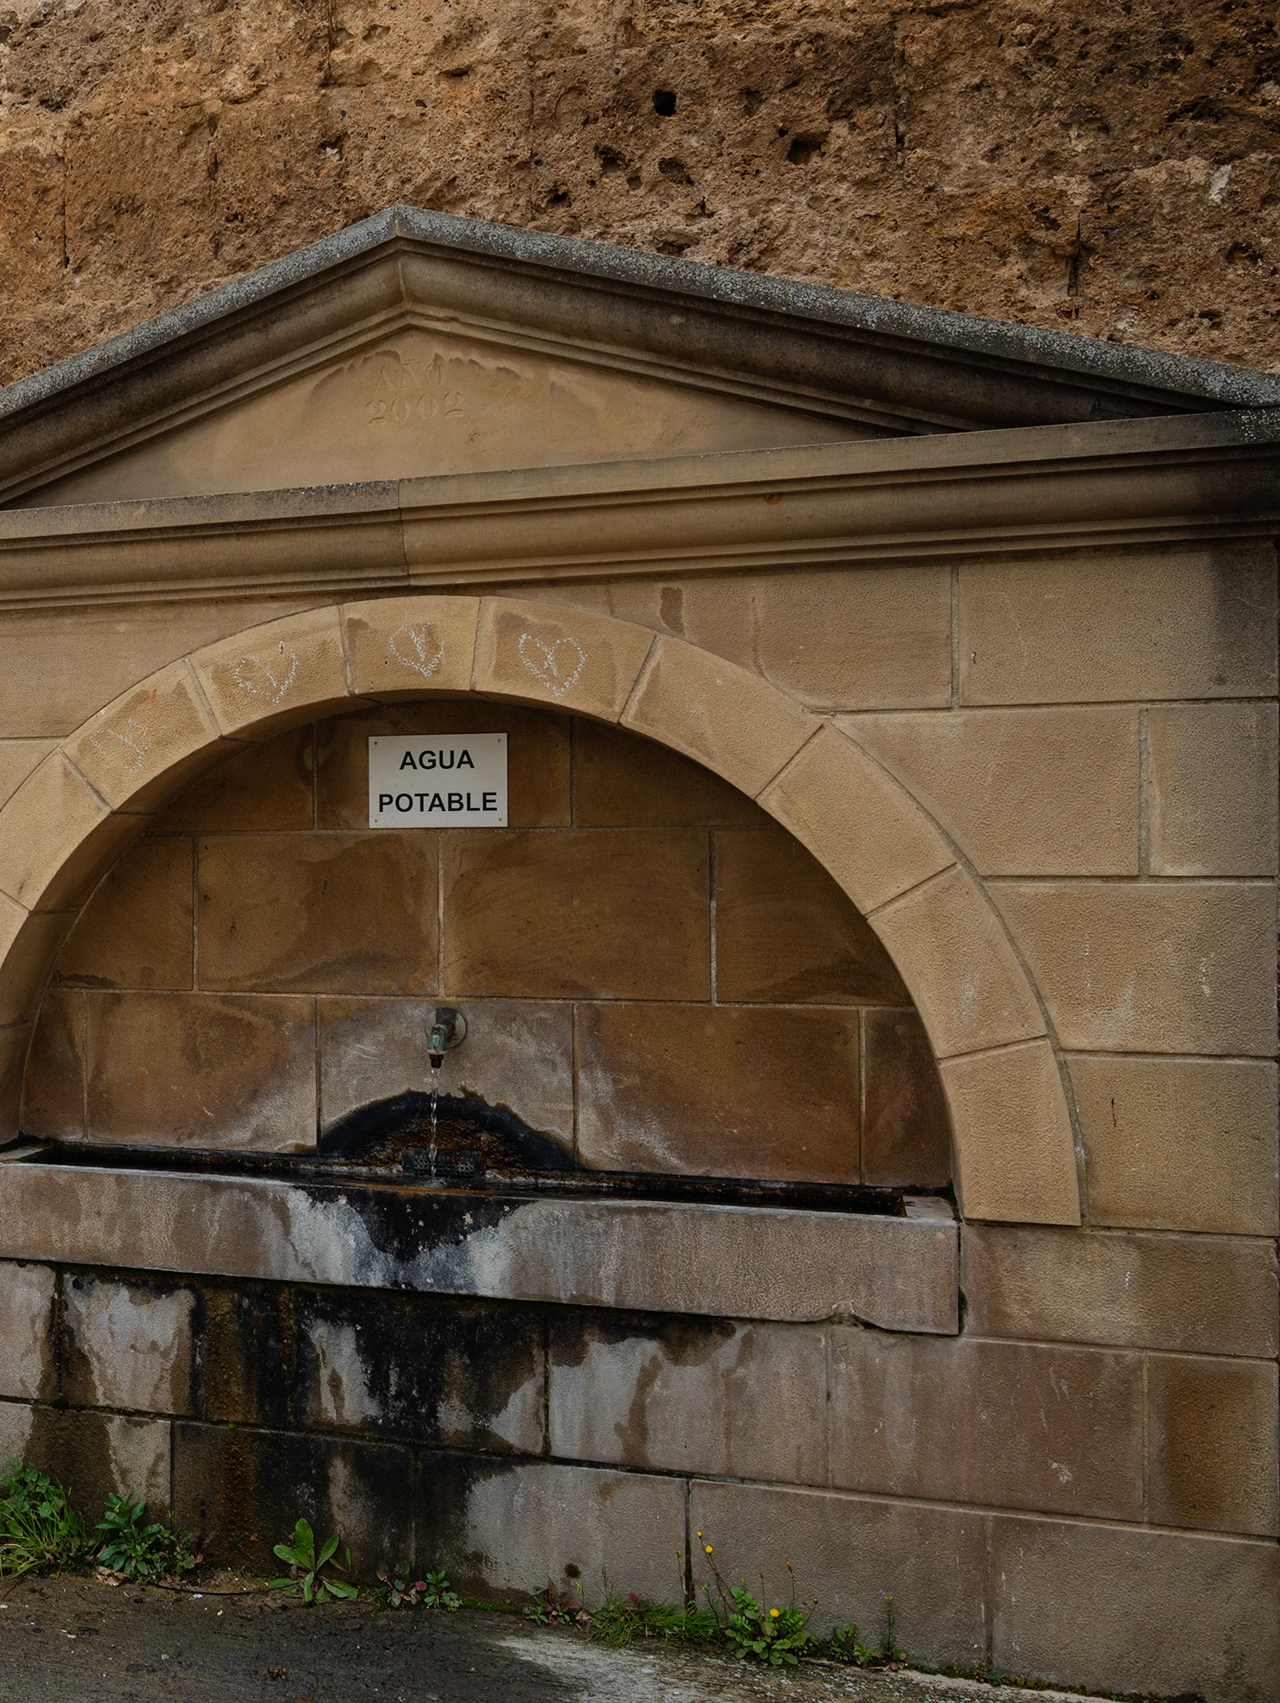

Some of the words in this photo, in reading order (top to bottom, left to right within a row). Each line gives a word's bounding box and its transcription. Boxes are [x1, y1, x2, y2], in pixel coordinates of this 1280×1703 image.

[365, 391, 464, 426] 2002
[399, 750, 475, 770] AGUA
[378, 792, 498, 813] POTABLE
